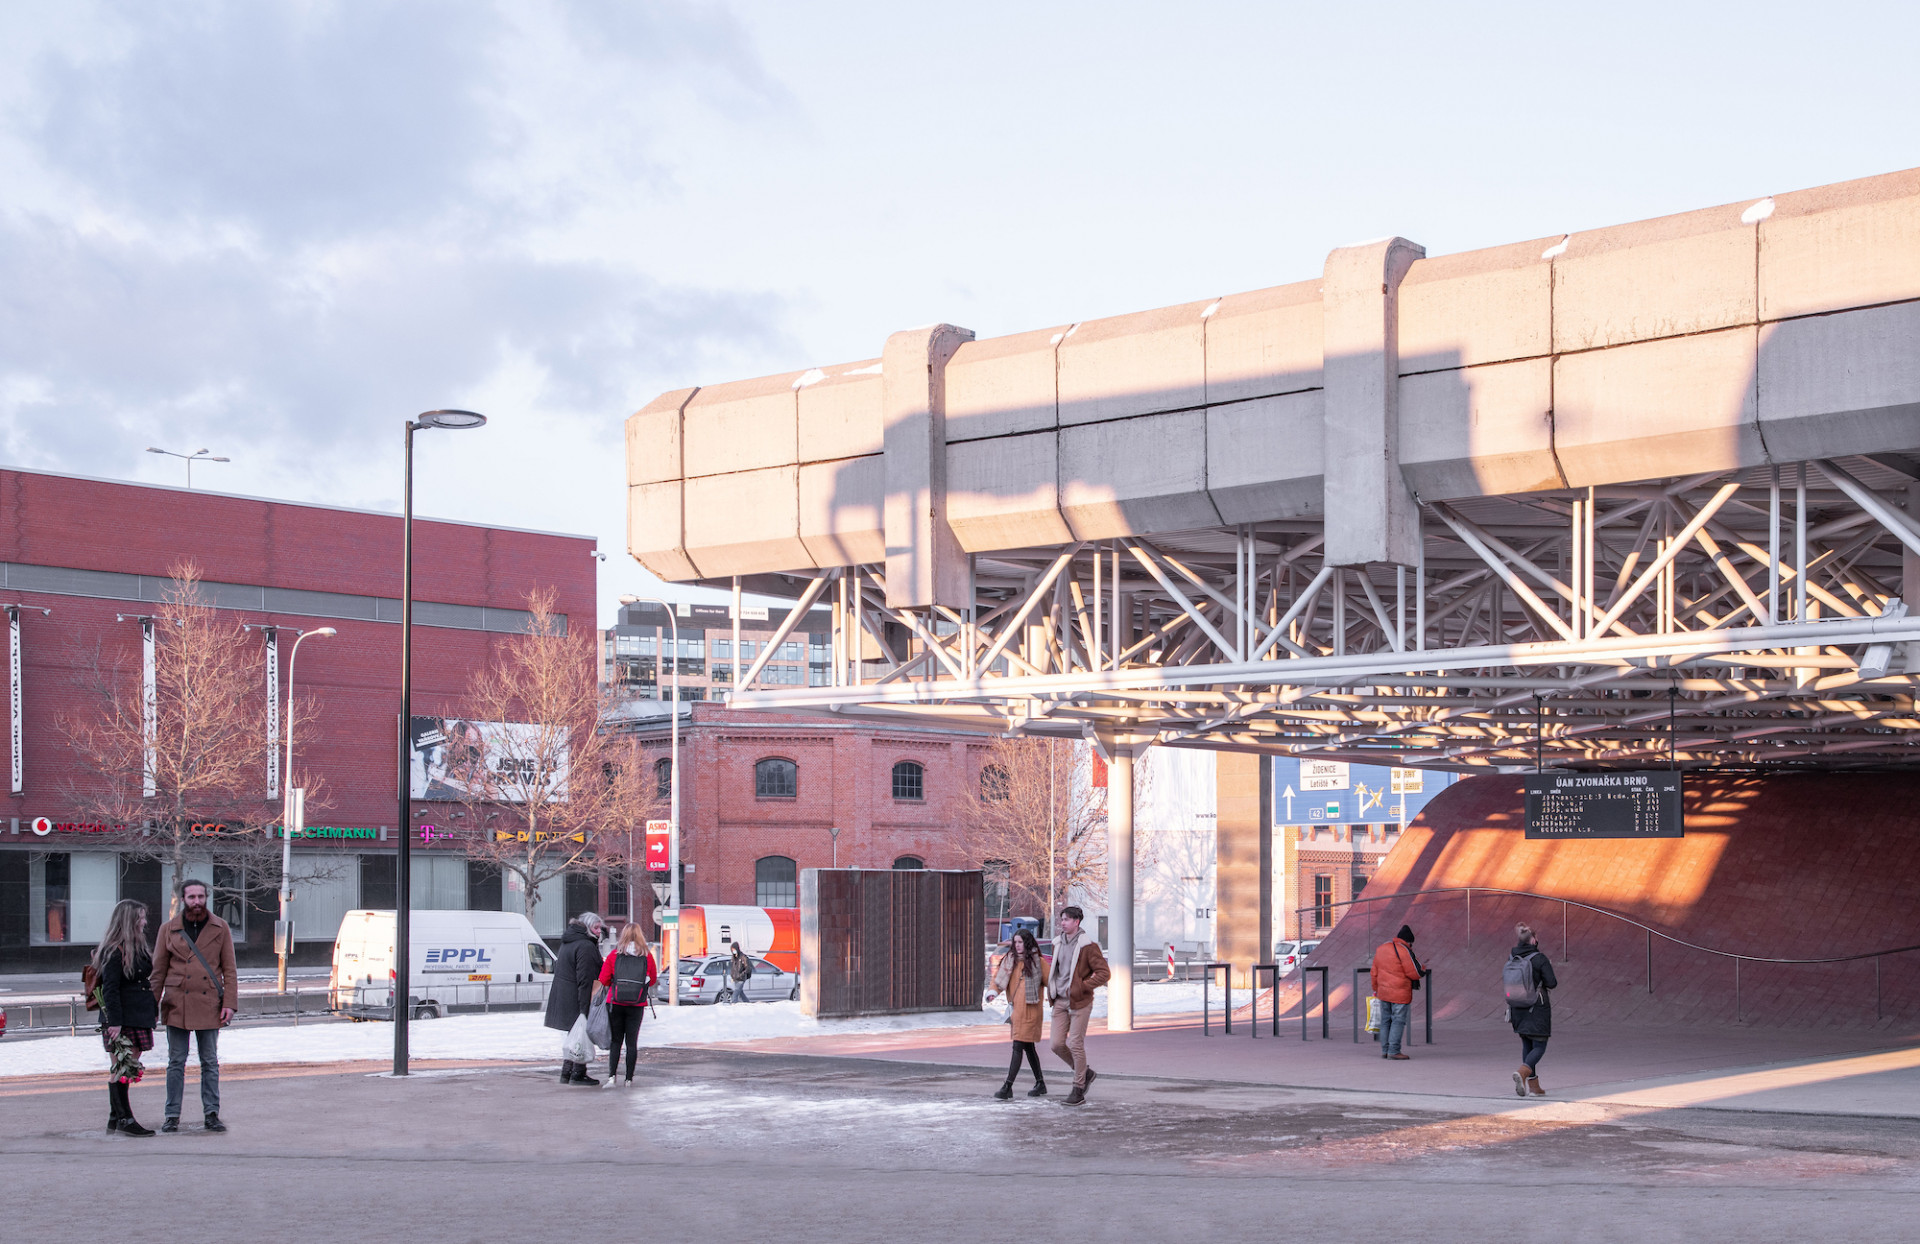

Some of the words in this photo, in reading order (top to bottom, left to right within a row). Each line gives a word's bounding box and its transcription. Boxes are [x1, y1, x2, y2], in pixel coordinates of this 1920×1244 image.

[1312, 764, 1336, 774] ŽIDENICE
[1556, 776, 1574, 787] ÚAN
[1575, 774, 1622, 787] ZVONAŘKA
[1623, 776, 1648, 786] BRNO
[1312, 809, 1321, 817] 42
[648, 822, 668, 831] ASKO
[441, 948, 492, 963] PPL
